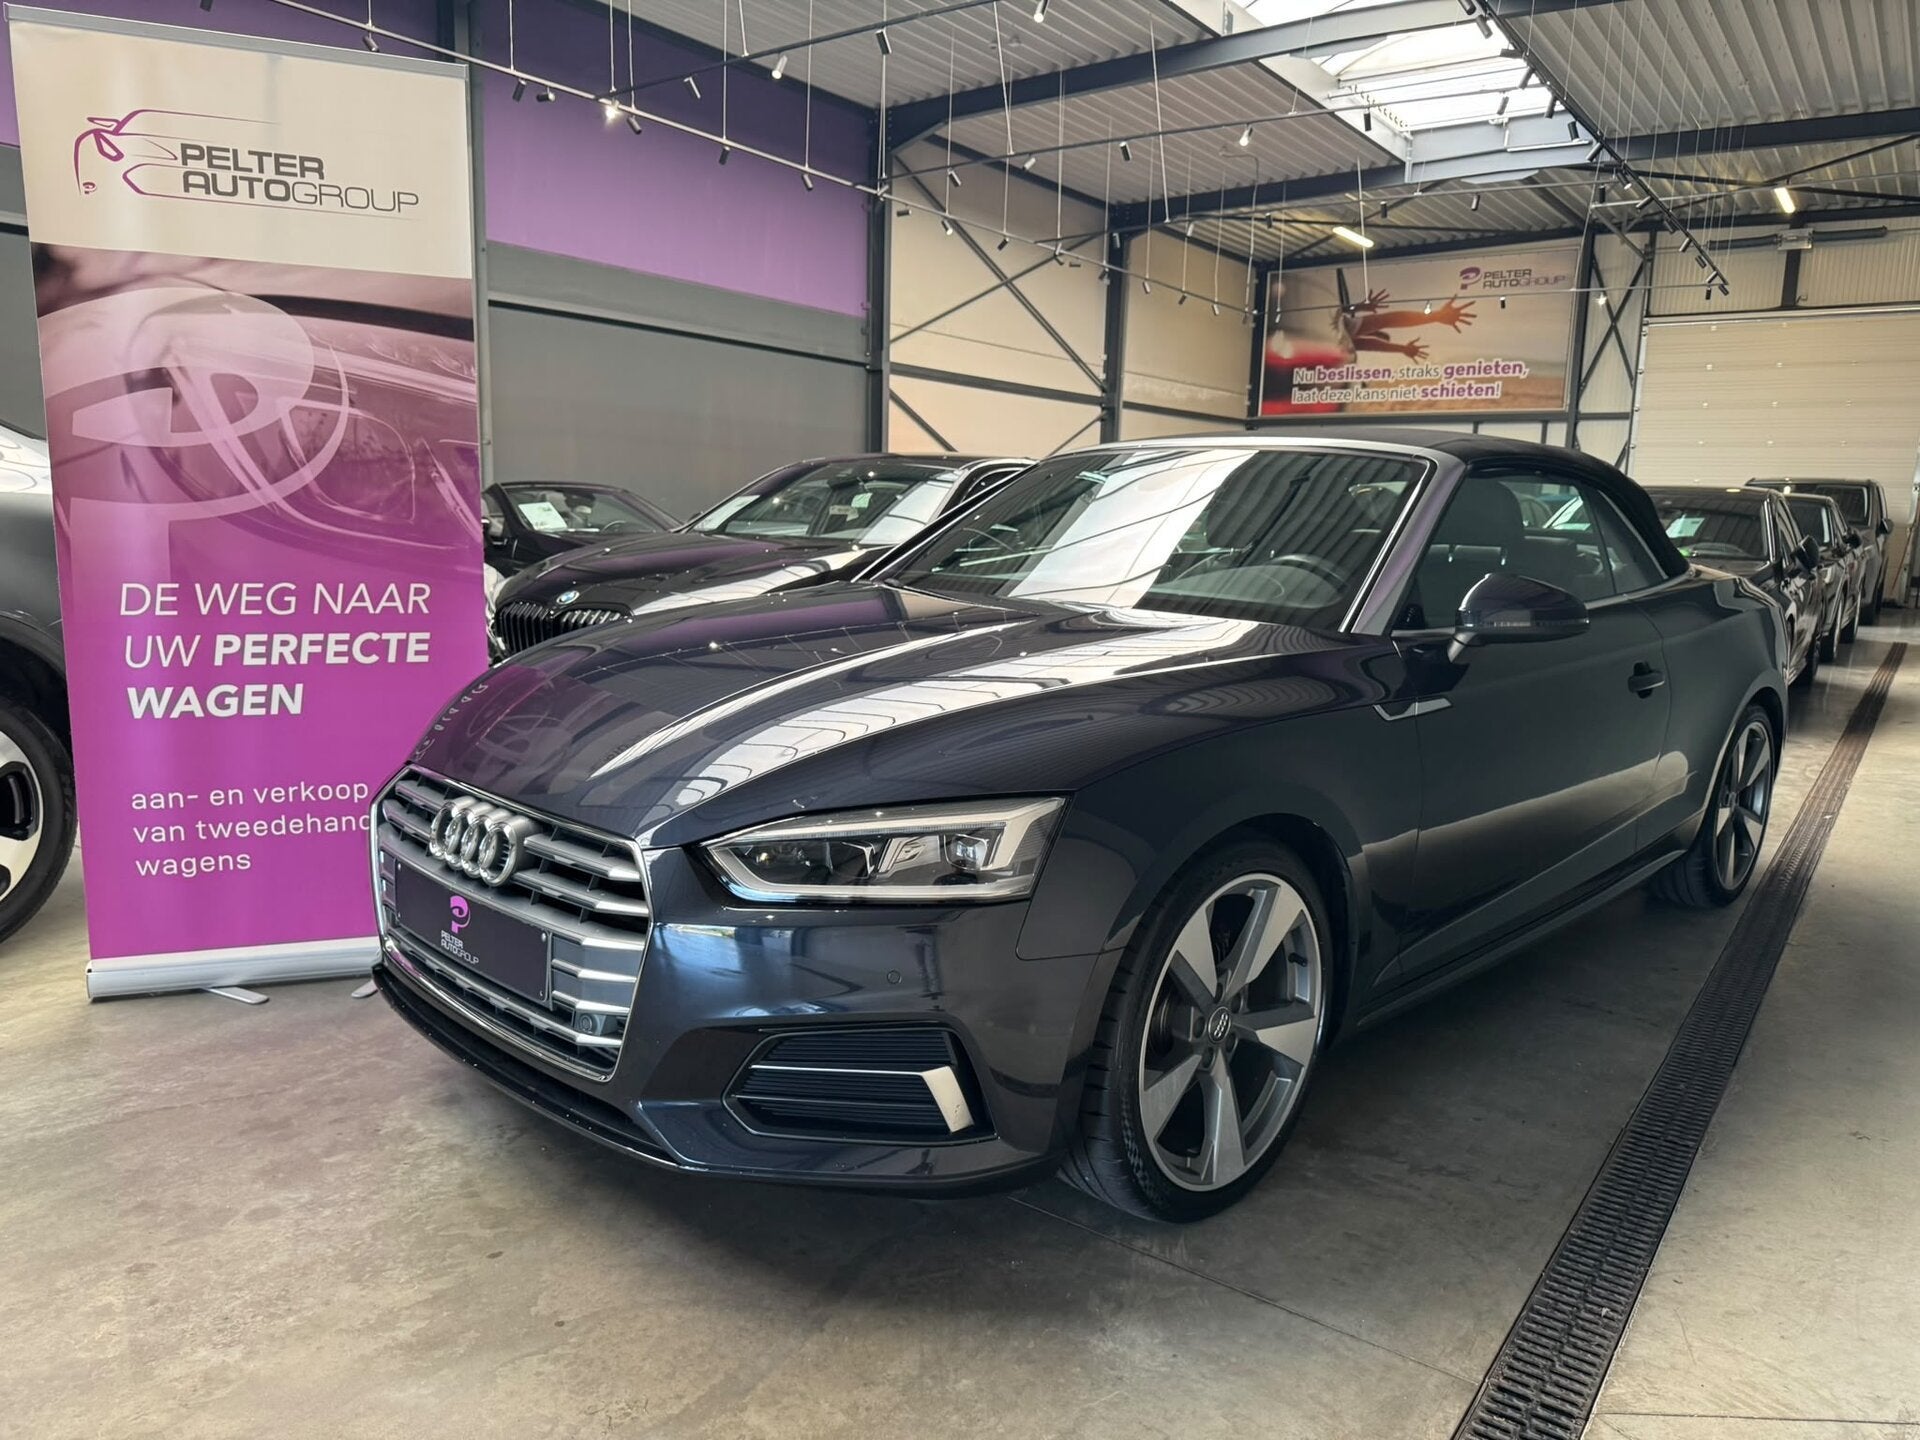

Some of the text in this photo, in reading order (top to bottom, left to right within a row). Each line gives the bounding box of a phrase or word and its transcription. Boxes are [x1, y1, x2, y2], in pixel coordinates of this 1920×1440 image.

[180, 142, 326, 180] PELTER
[182, 170, 420, 213] AUTOGROUP
[1483, 268, 1533, 280] PELTER
[1483, 275, 1566, 289] AUTOGROUP
[1294, 361, 1528, 382] Nu beslissen, straks genieten,
[1292, 383, 1501, 402] laat deze kans niet schieten!
[120, 582, 431, 616] DE WEG NAAR
[124, 631, 431, 669] UW PERFECTE
[126, 683, 304, 720] WAGEN
[131, 781, 369, 810] aan- en verkoop
[133, 823, 186, 844] van
[135, 852, 252, 878] wagens
[441, 930, 463, 949] PELTER
[441, 939, 479, 964] AUTOGROUP
